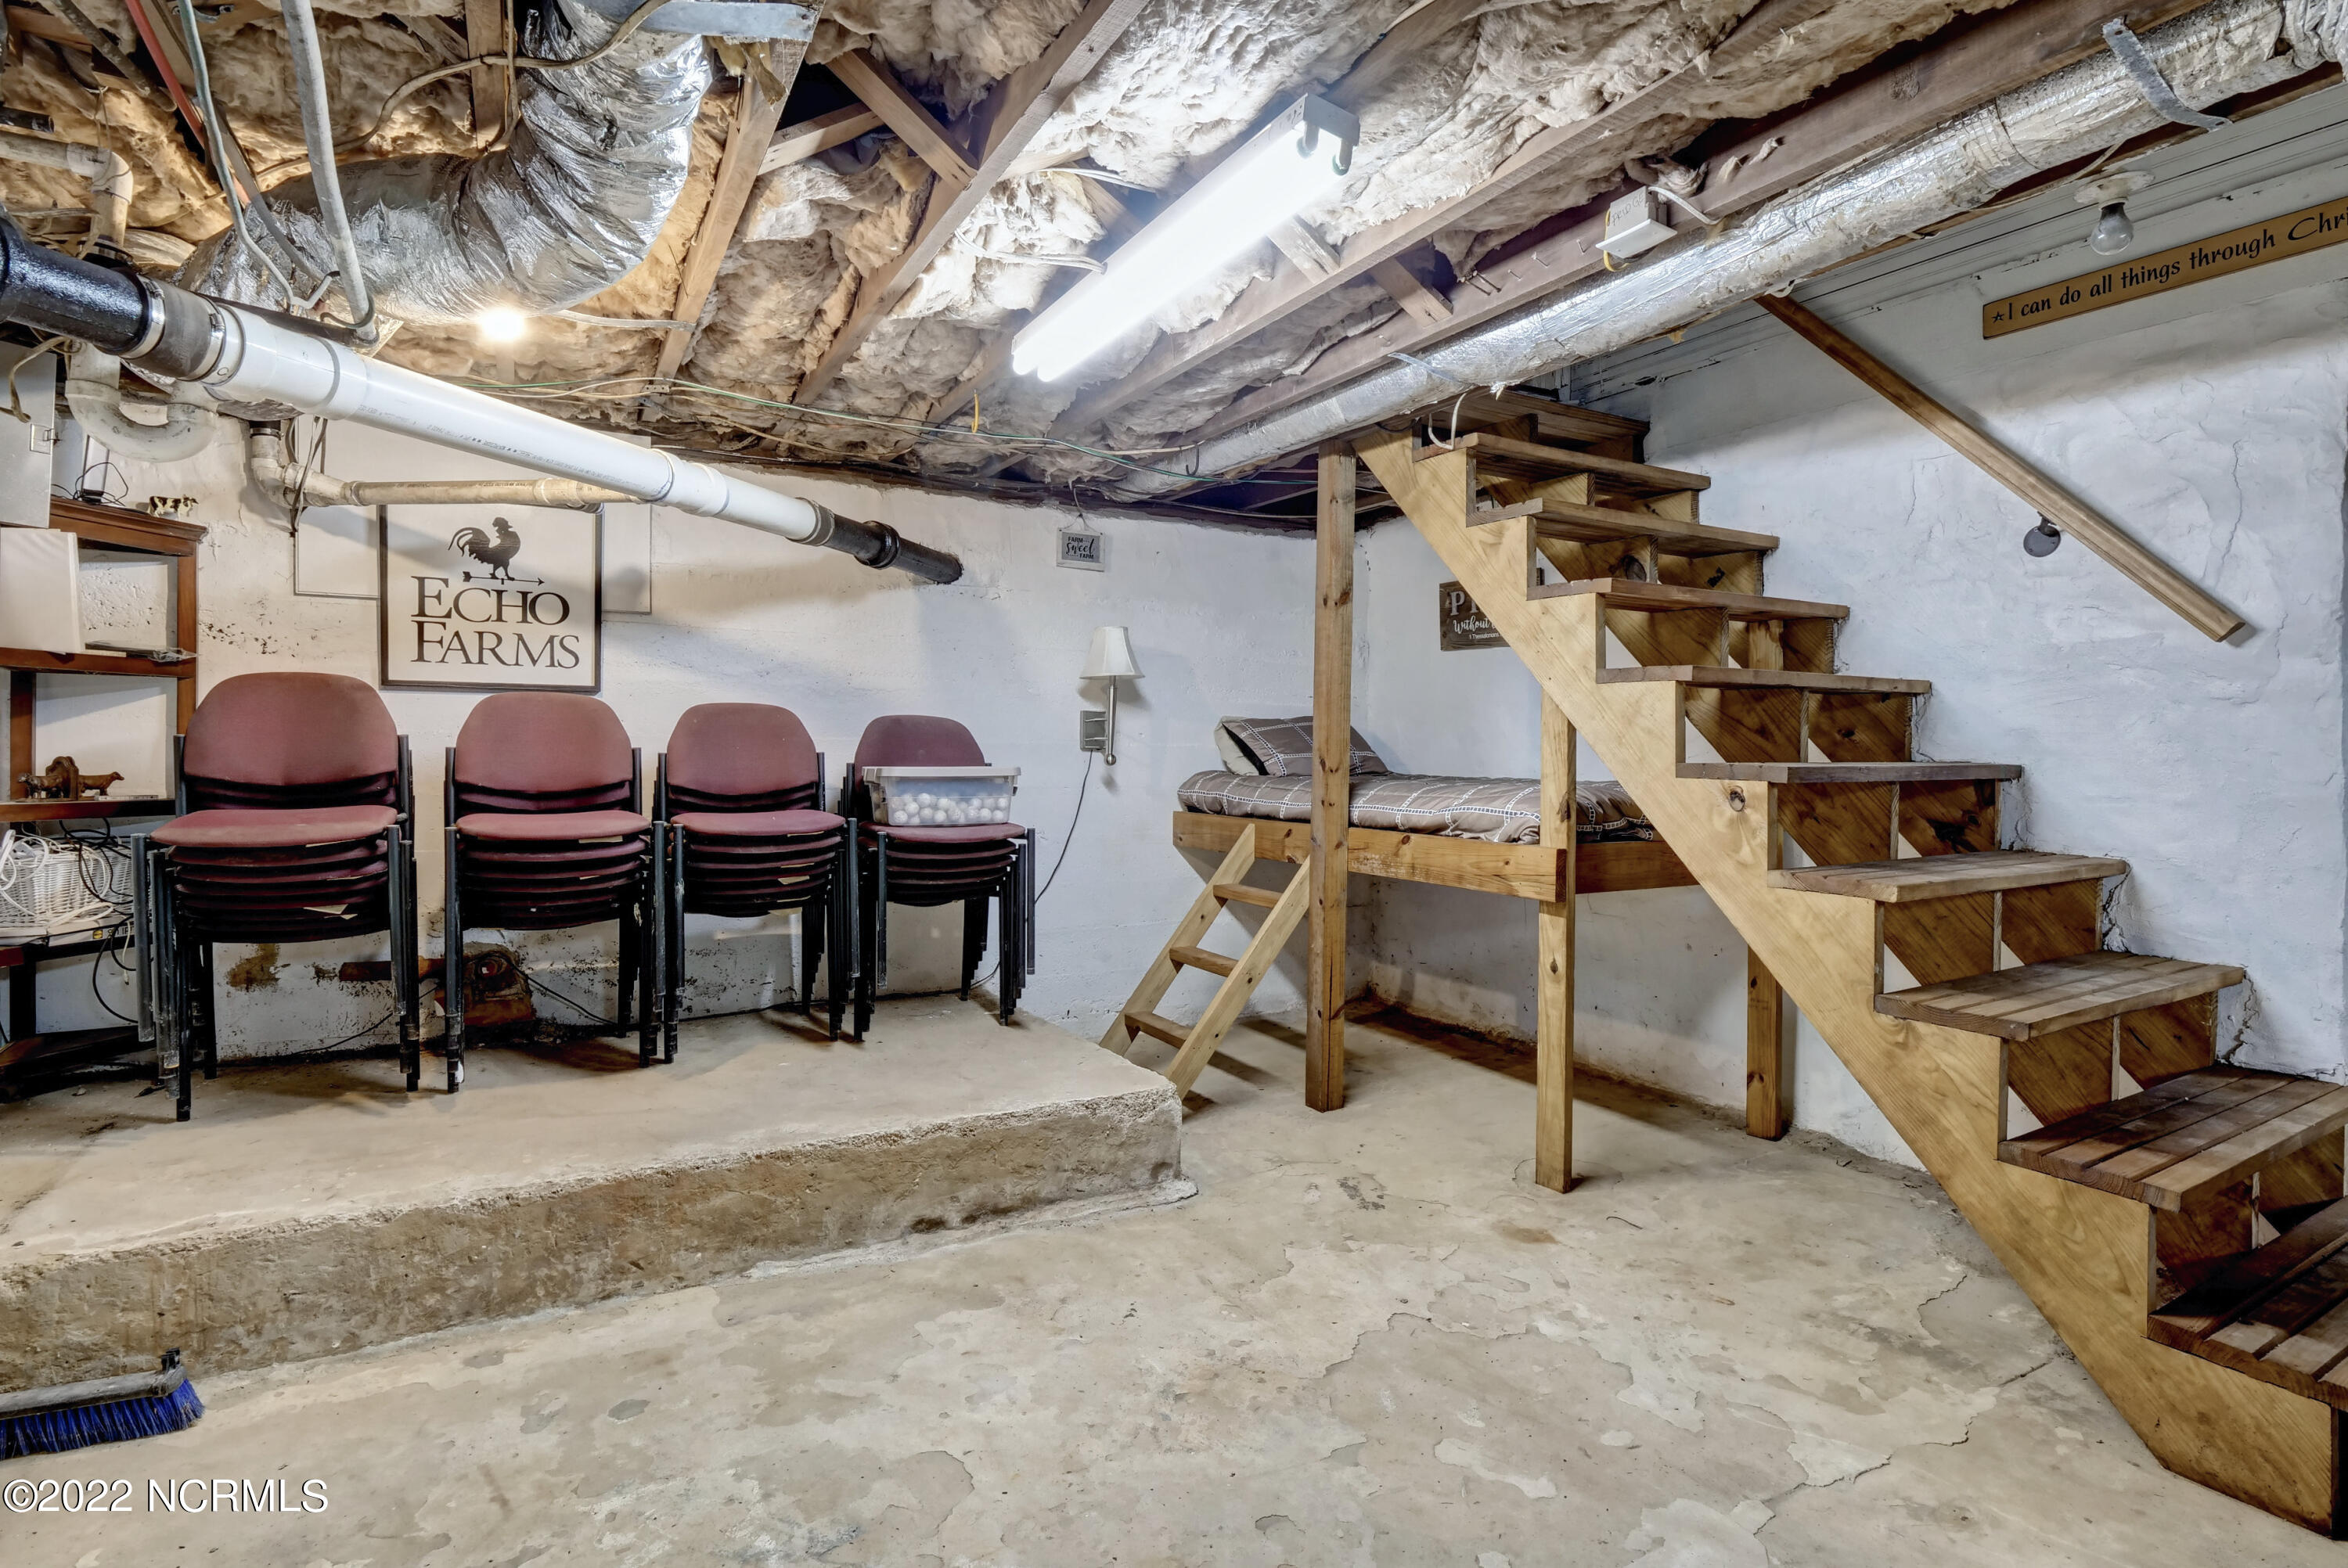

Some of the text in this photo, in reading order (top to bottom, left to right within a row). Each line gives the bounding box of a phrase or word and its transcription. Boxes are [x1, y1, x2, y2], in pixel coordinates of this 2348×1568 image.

[2008, 302, 2013, 320] I
[2021, 297, 2051, 317] can
[2059, 286, 2081, 306] do
[2090, 274, 2112, 297] all
[2120, 261, 2181, 289] things
[2189, 228, 2275, 270] through
[411, 576, 570, 625] ECHO
[1453, 615, 1490, 634] Without
[411, 620, 580, 669] FARMS
